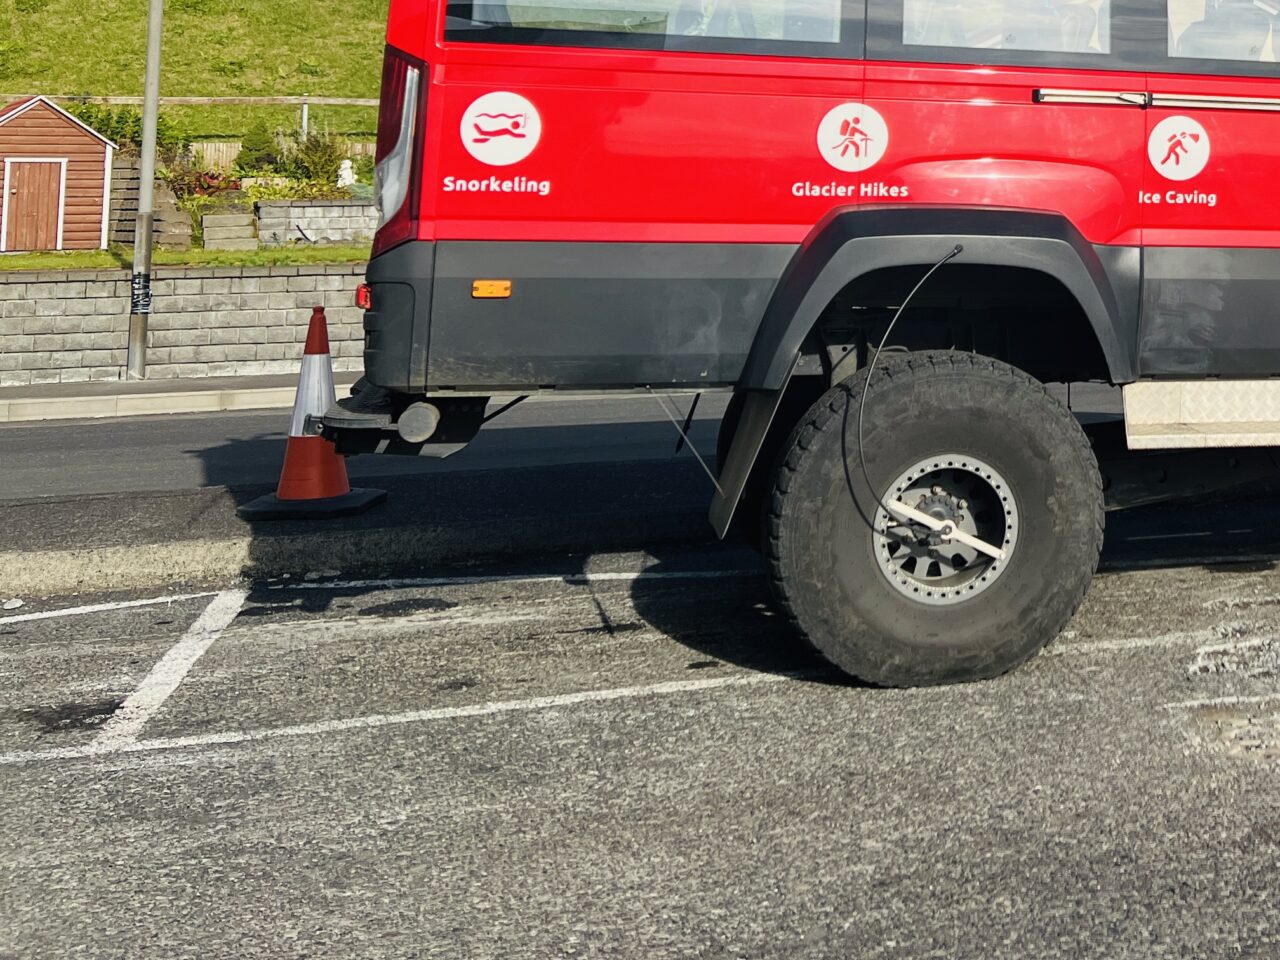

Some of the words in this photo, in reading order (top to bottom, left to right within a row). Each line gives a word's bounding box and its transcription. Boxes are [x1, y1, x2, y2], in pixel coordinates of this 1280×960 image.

[443, 176, 550, 196] Snorkeling
[792, 181, 855, 197] Glacier
[860, 182, 908, 197] Hikes
[1138, 190, 1161, 204] Ice
[1165, 190, 1216, 207] Caving
